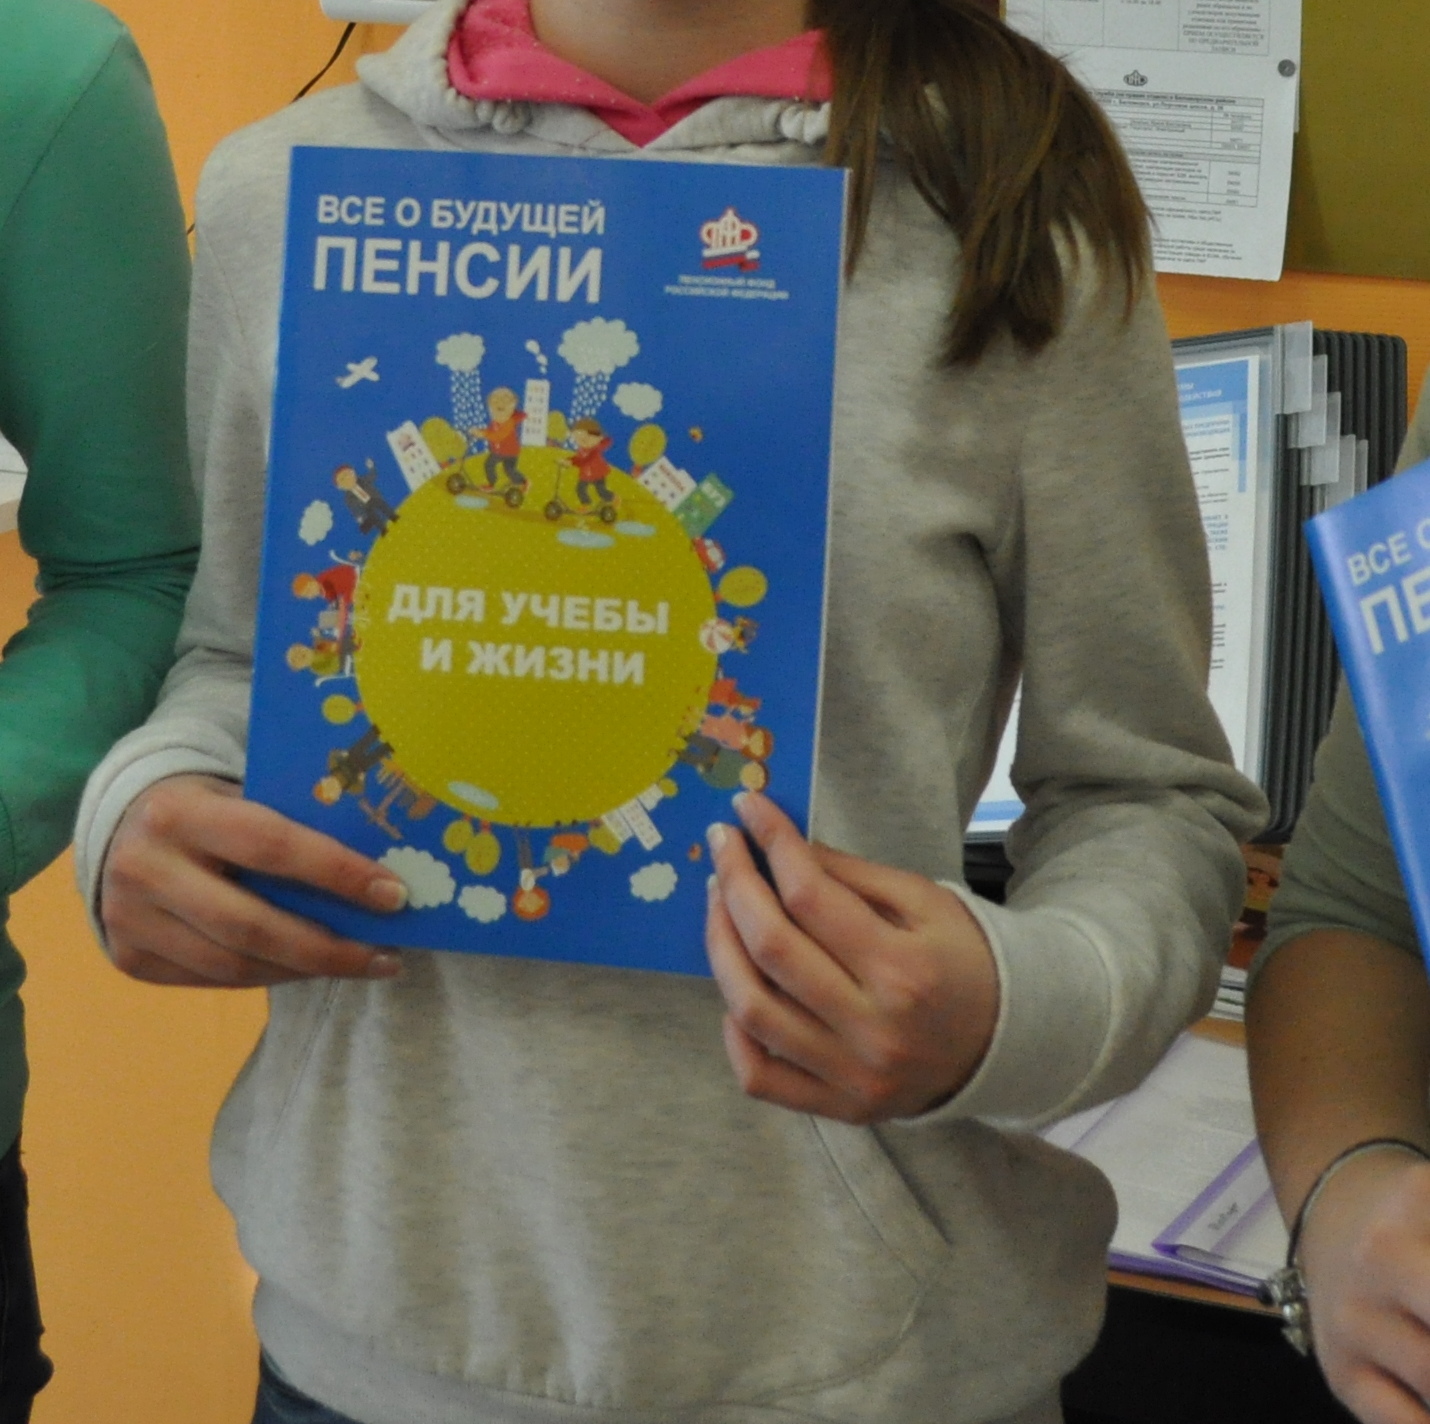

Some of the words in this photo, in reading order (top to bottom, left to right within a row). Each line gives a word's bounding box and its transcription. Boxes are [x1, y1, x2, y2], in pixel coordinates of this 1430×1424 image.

[316, 194, 385, 227] ВСЕ
[395, 197, 421, 227] О
[431, 199, 607, 237] БУДУЩЕЙ
[312, 236, 604, 304] ПЕНСИИ
[1346, 532, 1413, 587] ВСЕ
[387, 583, 487, 624] ДЛЯ
[501, 591, 670, 635] УЧЕБЫ
[420, 637, 453, 673] И
[467, 641, 646, 686] ЖИЗНИ
